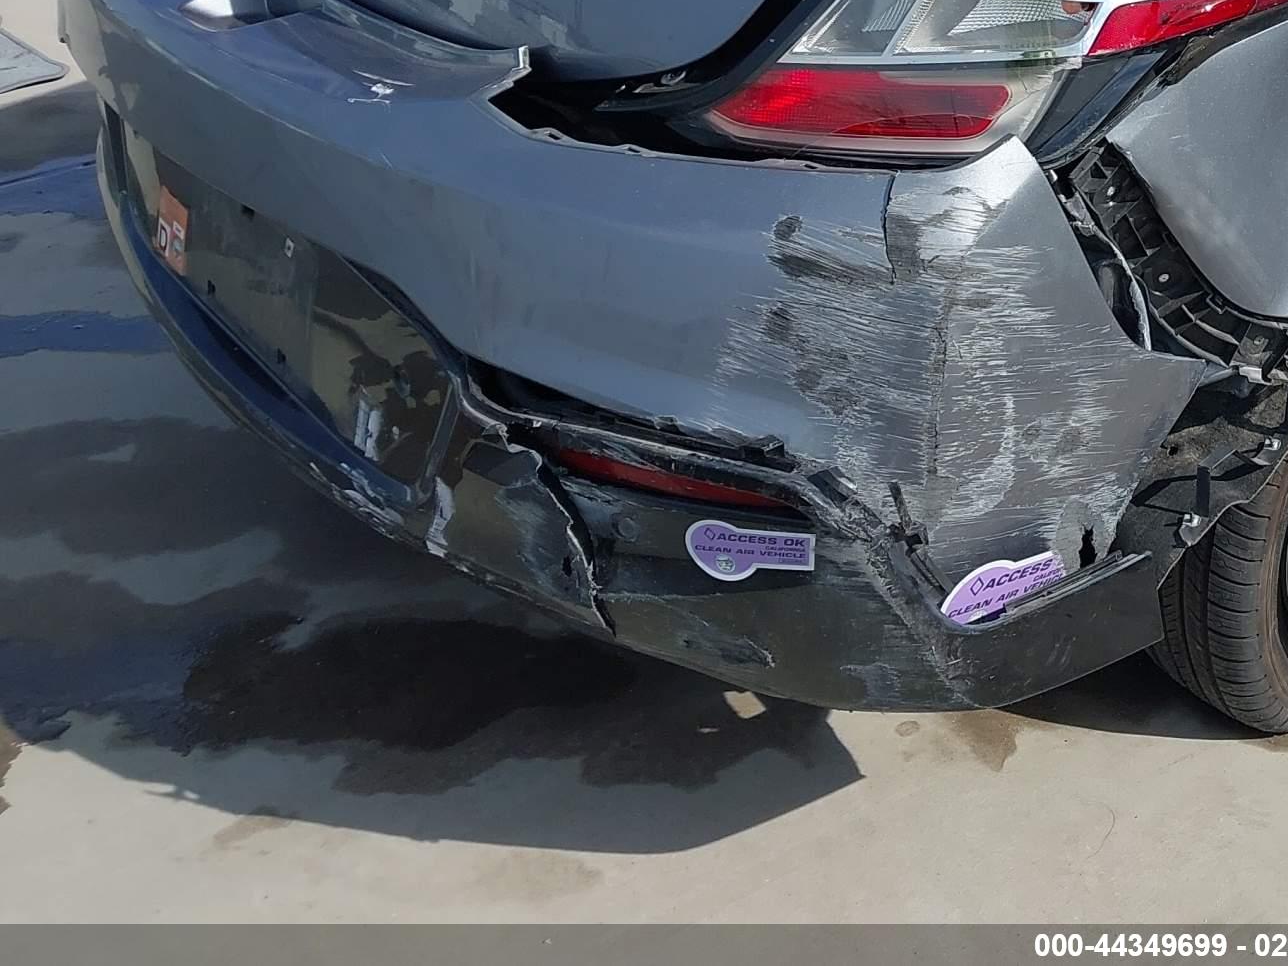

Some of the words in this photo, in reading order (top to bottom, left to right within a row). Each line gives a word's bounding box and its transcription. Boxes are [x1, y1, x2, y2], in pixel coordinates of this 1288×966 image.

[717, 533, 777, 545] ACCESS
[784, 538, 805, 547] OK
[695, 544, 732, 553] CLEAN
[760, 550, 806, 559] VEHICLE
[982, 559, 1053, 592] ACCESS
[948, 598, 994, 619] CLEAN
[996, 589, 1020, 604] AIR
